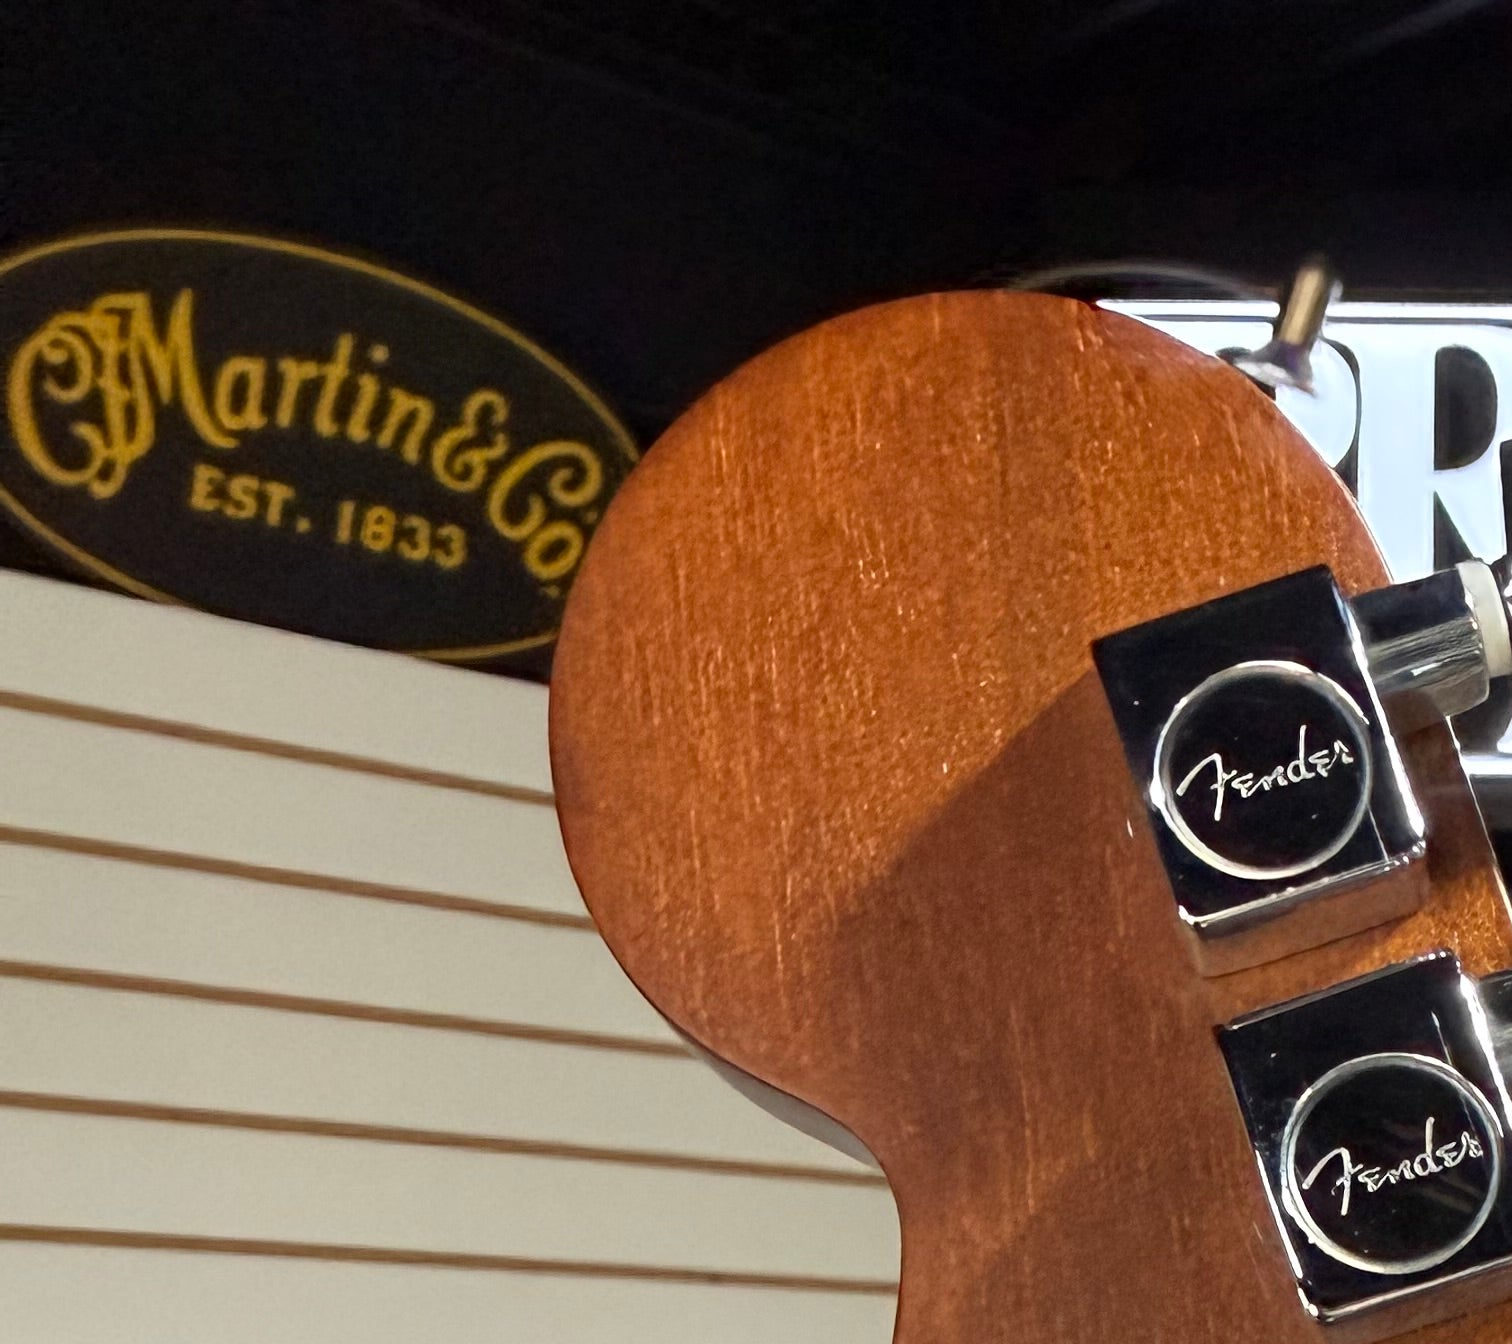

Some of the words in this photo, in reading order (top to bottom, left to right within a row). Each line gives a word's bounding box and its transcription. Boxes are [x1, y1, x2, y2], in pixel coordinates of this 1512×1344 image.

[190, 462, 311, 534] EST.
[335, 500, 469, 571] 1833
[1176, 724, 1354, 822] Fender
[1302, 1115, 1485, 1217] Fender
